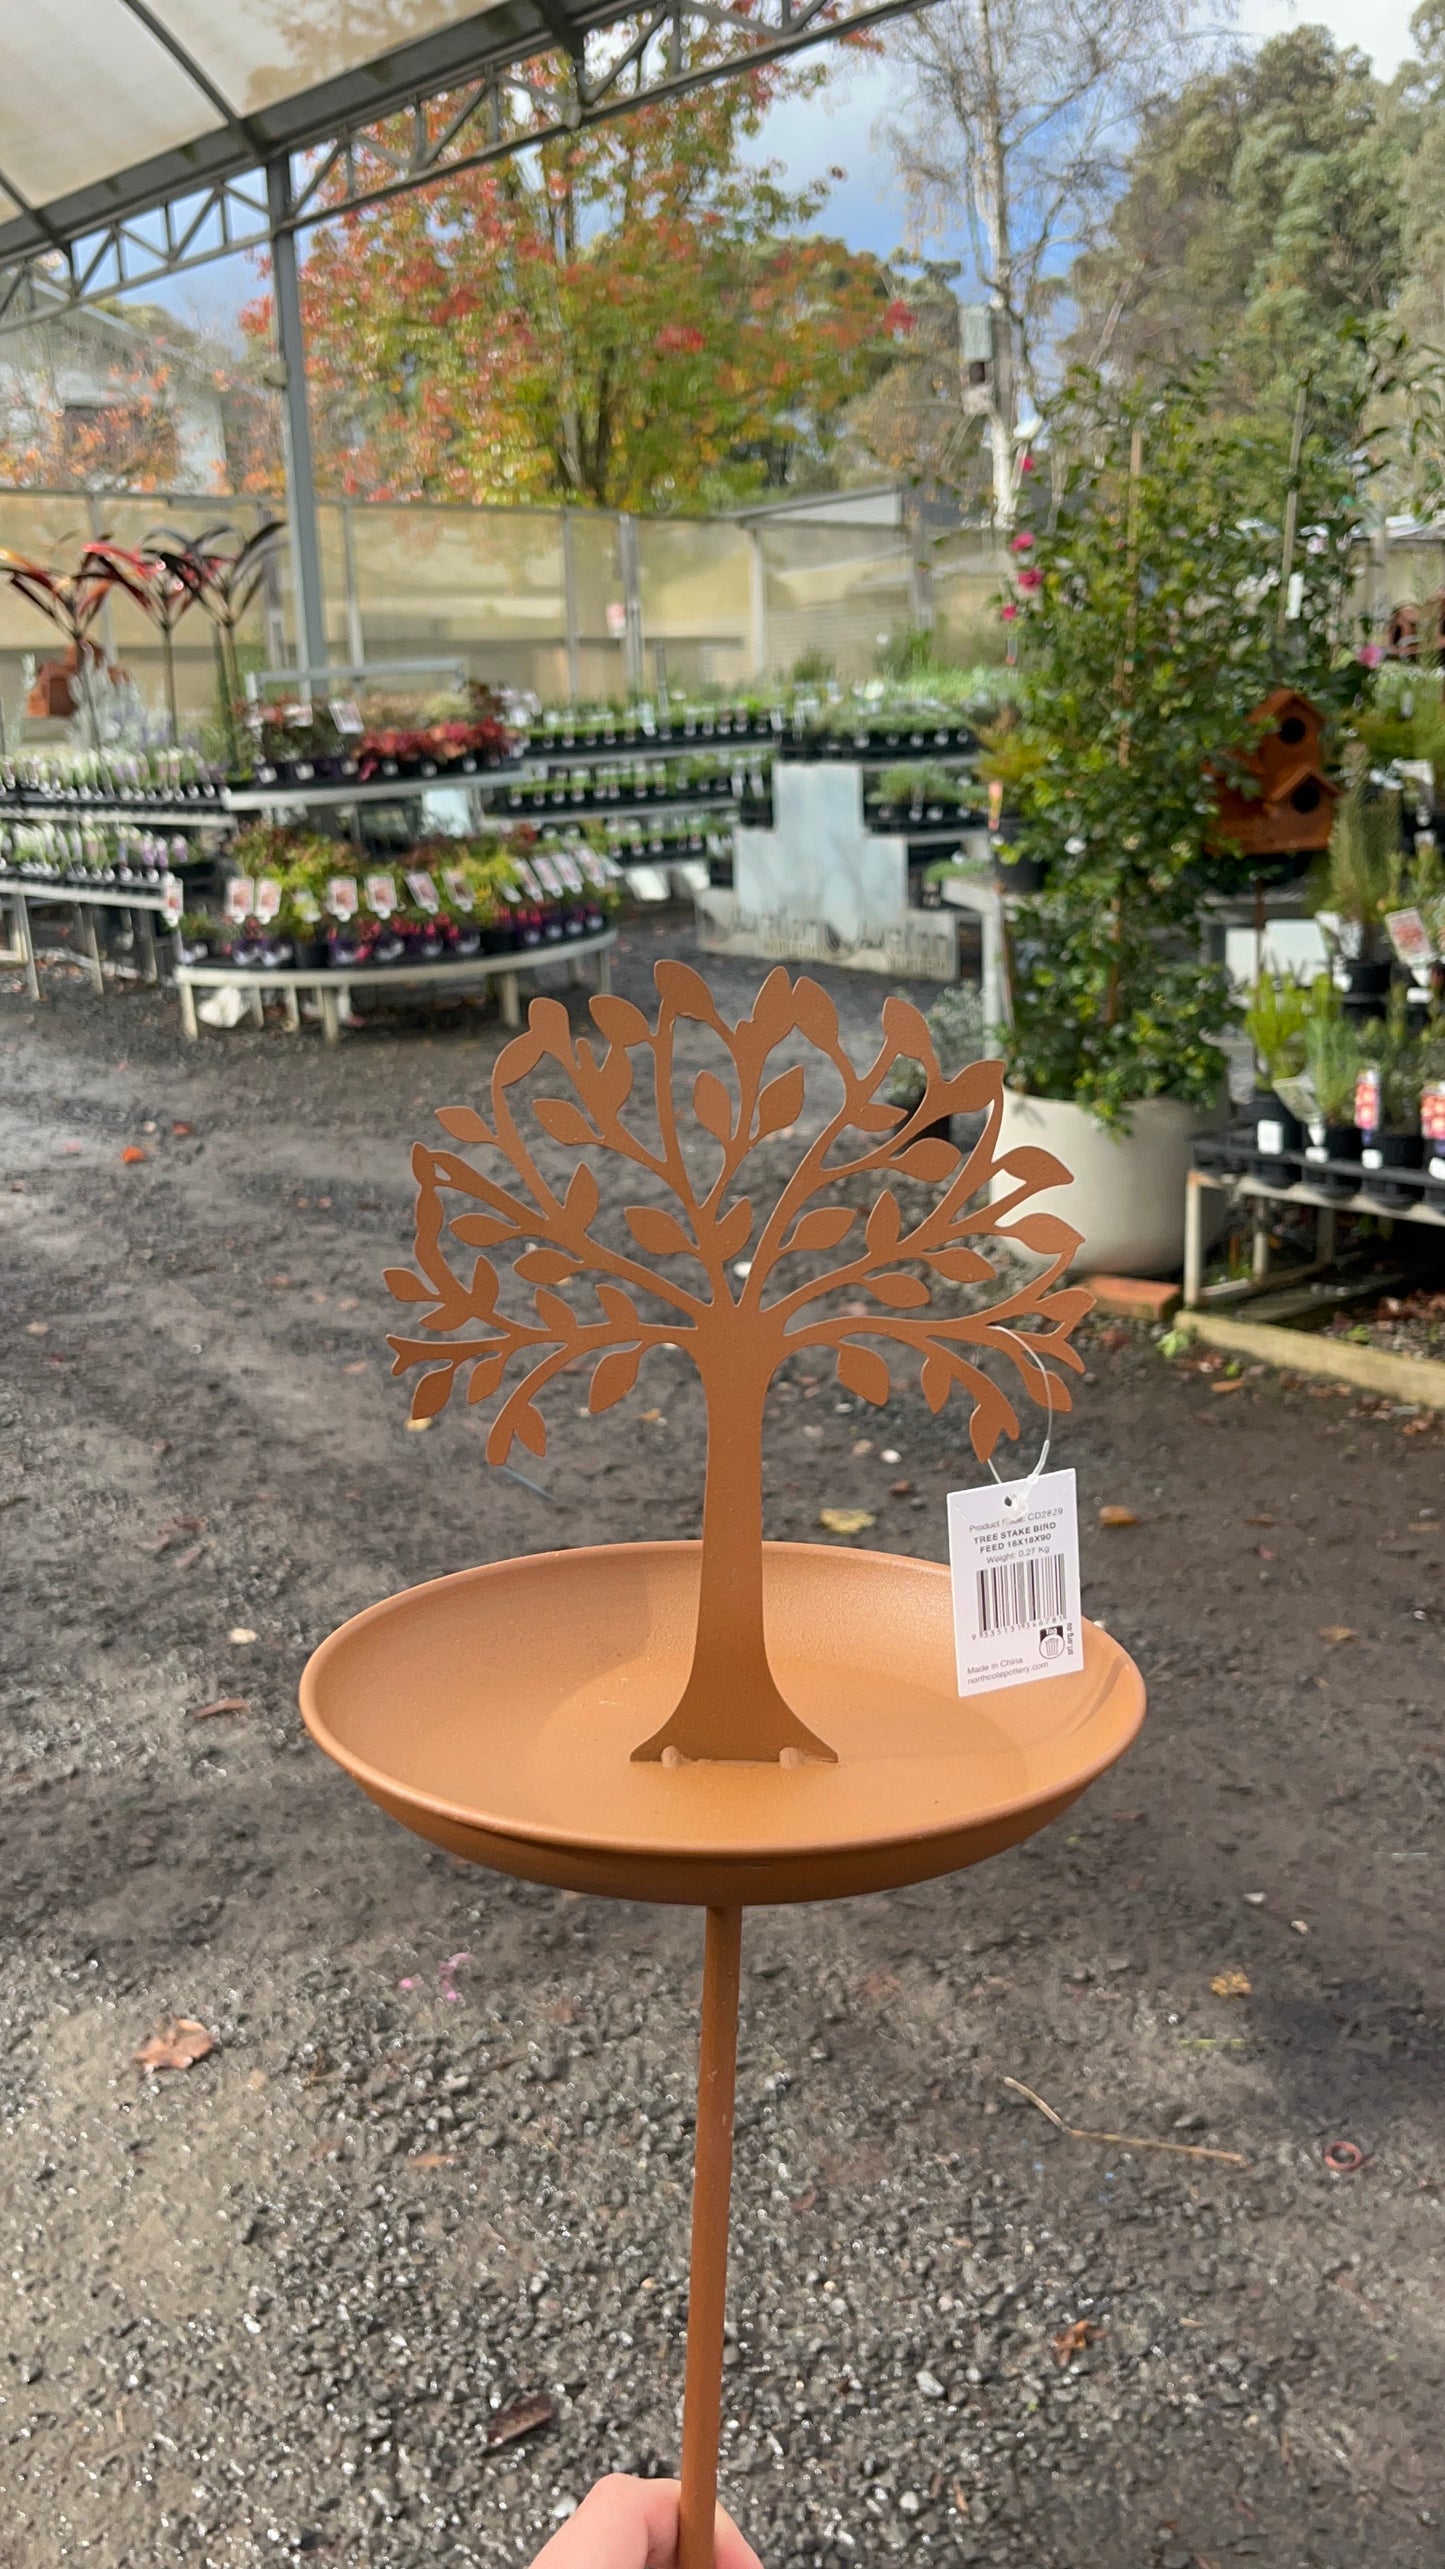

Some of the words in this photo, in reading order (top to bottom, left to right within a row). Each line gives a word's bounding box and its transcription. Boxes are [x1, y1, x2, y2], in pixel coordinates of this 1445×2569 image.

[969, 1520, 1000, 1532] Product
[974, 1533, 998, 1545] TREE
[1001, 1526, 1031, 1539] STAKE
[1034, 1521, 1056, 1533] BIRD
[980, 1542, 1005, 1553] FEED
[1008, 1533, 1052, 1548] 18X18X90
[987, 1553, 1016, 1564] Weight:
[1018, 1547, 1035, 1557] 0.27
[1038, 1545, 1050, 1553] Kg
[967, 1665, 989, 1674] Made
[1000, 1657, 1023, 1667] China
